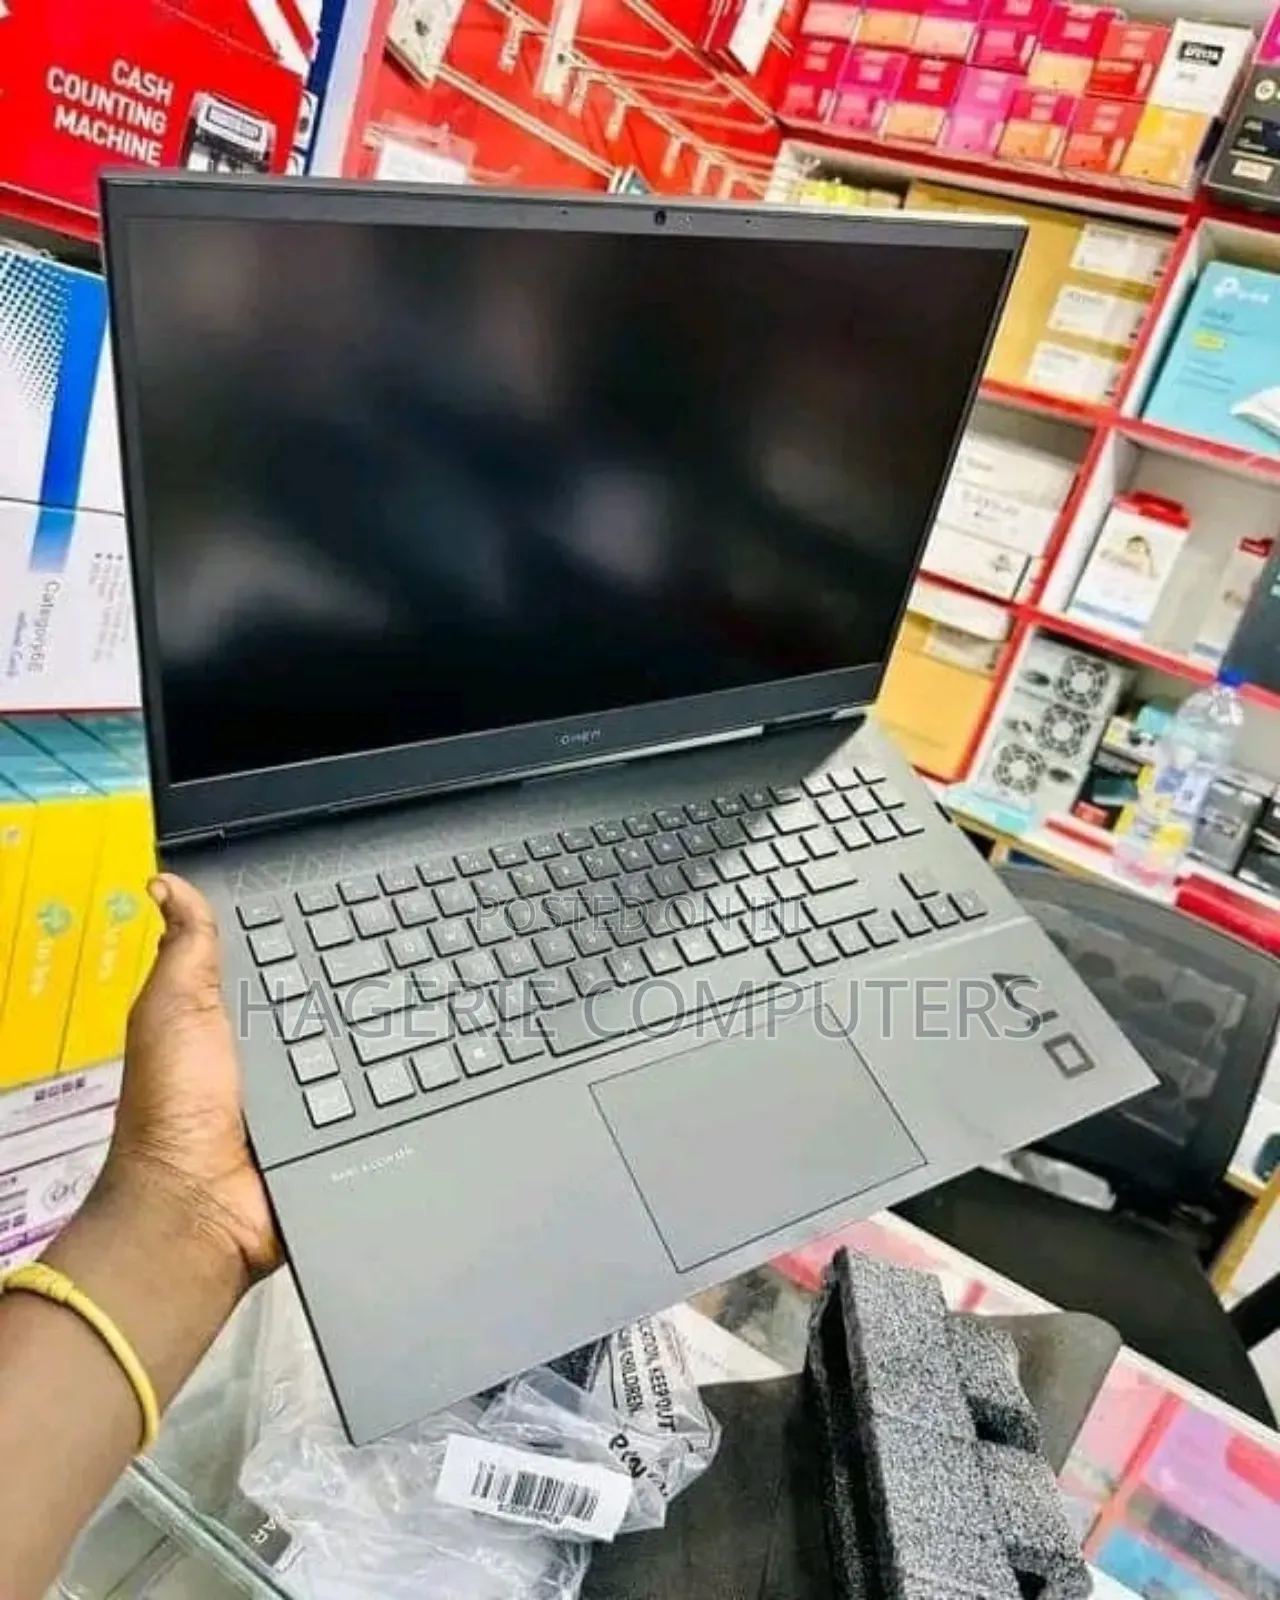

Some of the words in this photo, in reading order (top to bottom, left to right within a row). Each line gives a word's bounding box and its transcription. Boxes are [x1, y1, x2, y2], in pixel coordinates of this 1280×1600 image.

[46, 65, 167, 136] COUNTING
[111, 58, 174, 107] CASH
[54, 102, 163, 168] MACHINE
